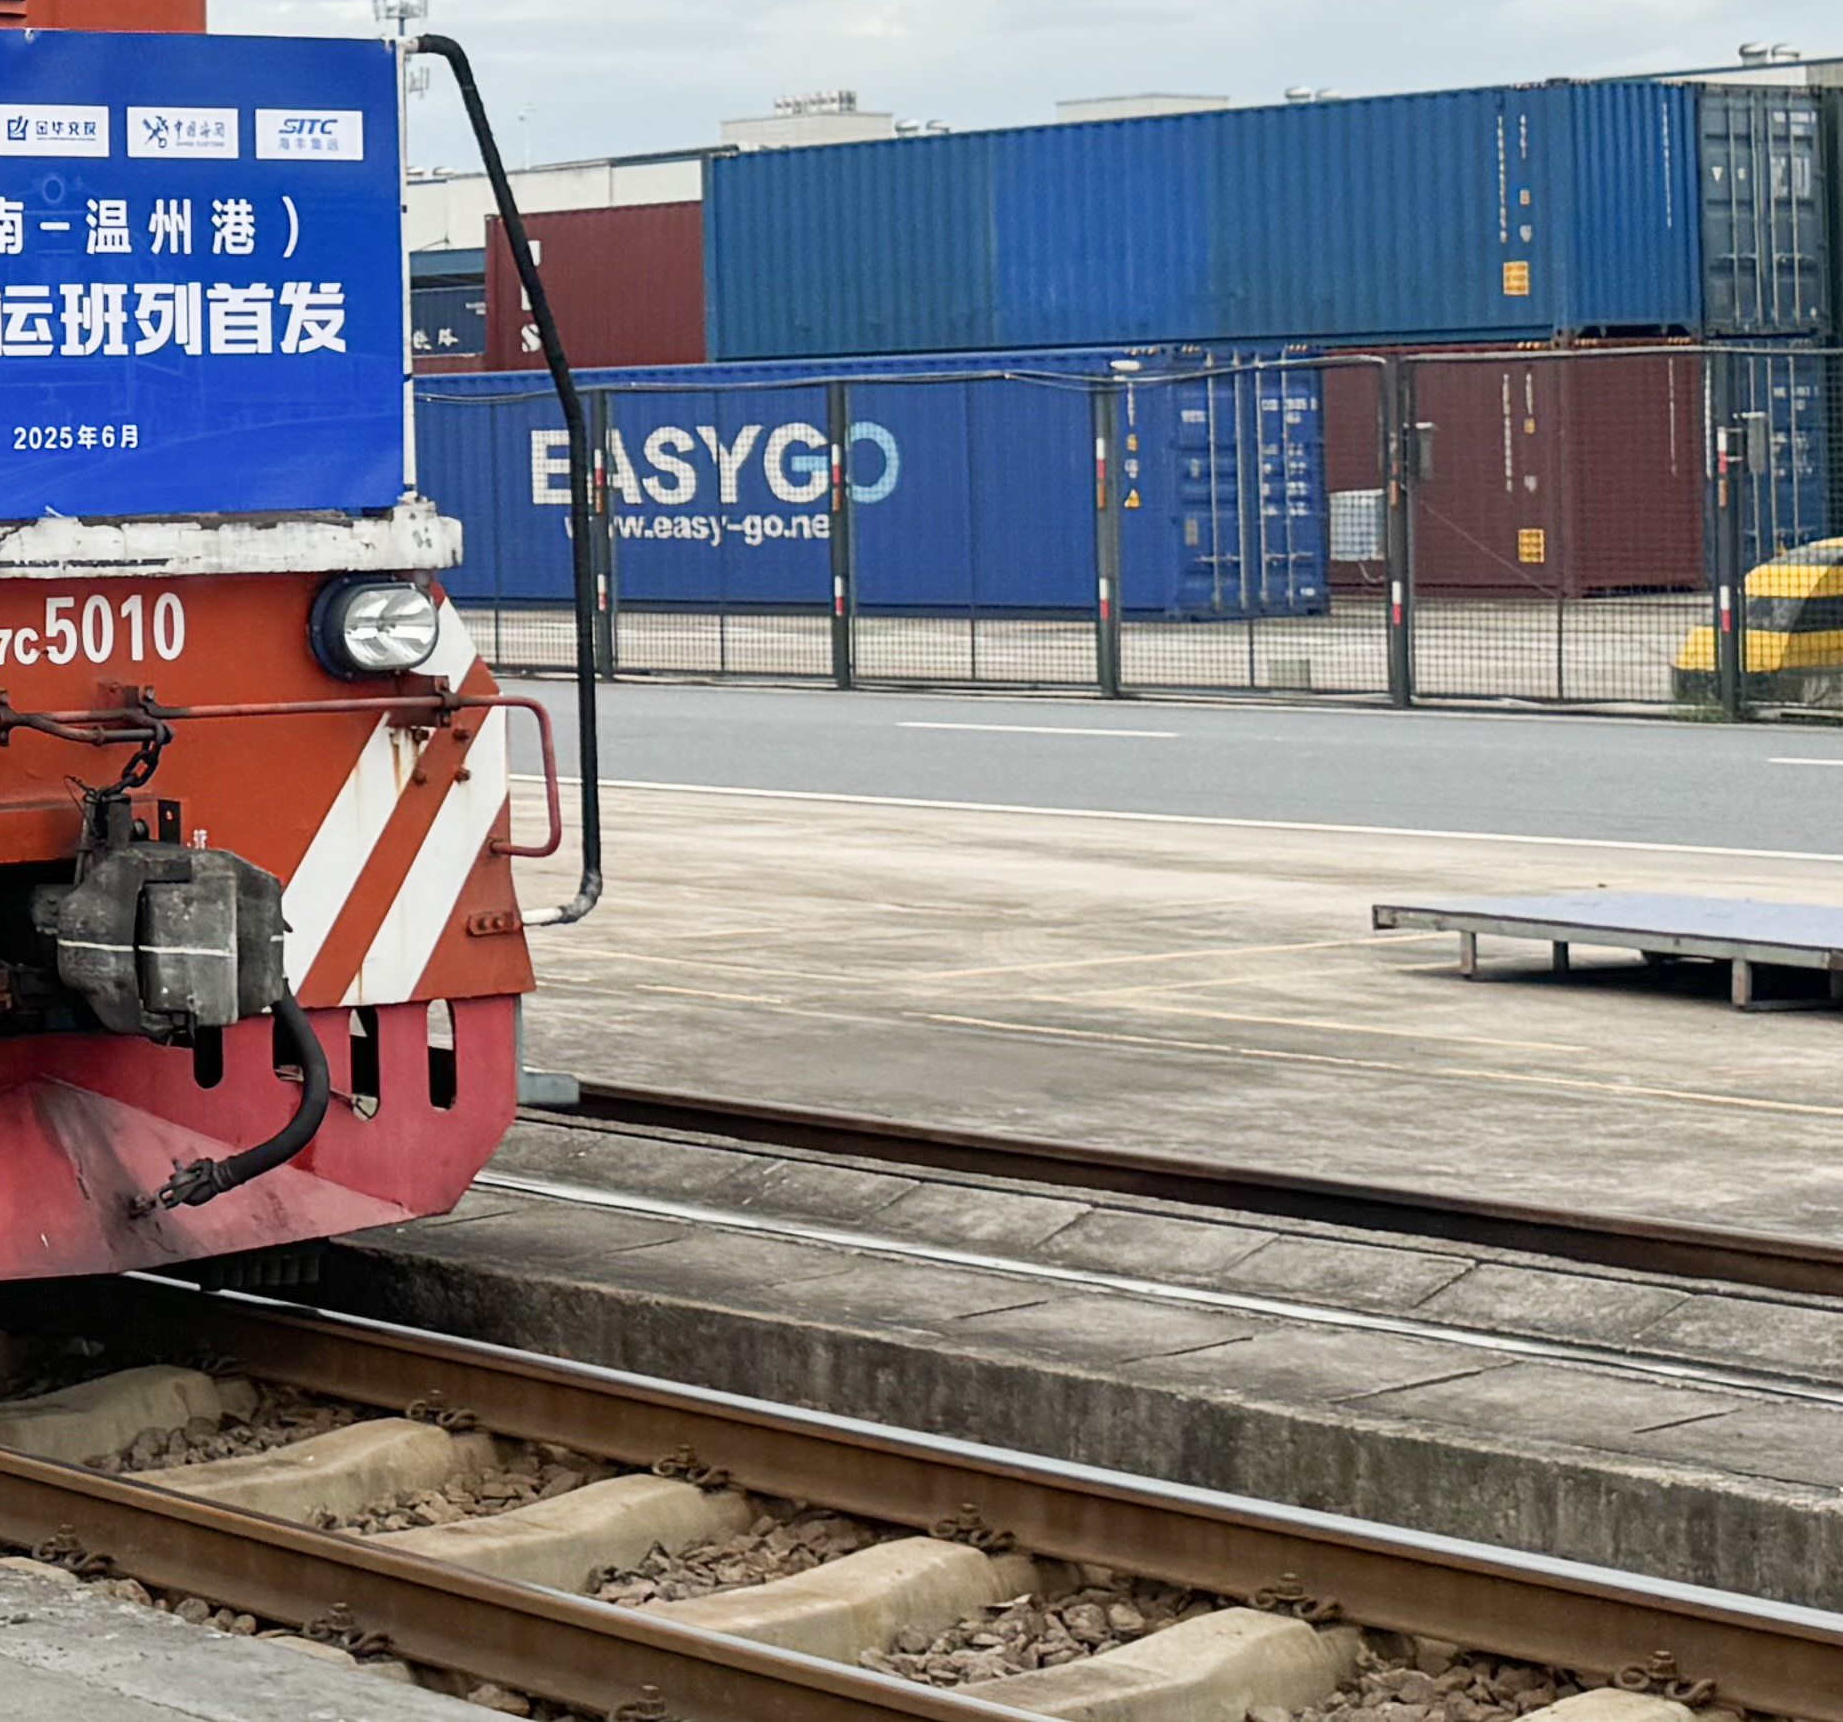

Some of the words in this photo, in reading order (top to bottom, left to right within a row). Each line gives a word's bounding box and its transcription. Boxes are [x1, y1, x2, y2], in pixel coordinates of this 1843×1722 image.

[278, 118, 338, 135] SITC
[12, 424, 141, 451] 2025年6月
[530, 421, 900, 505] EASYGO
